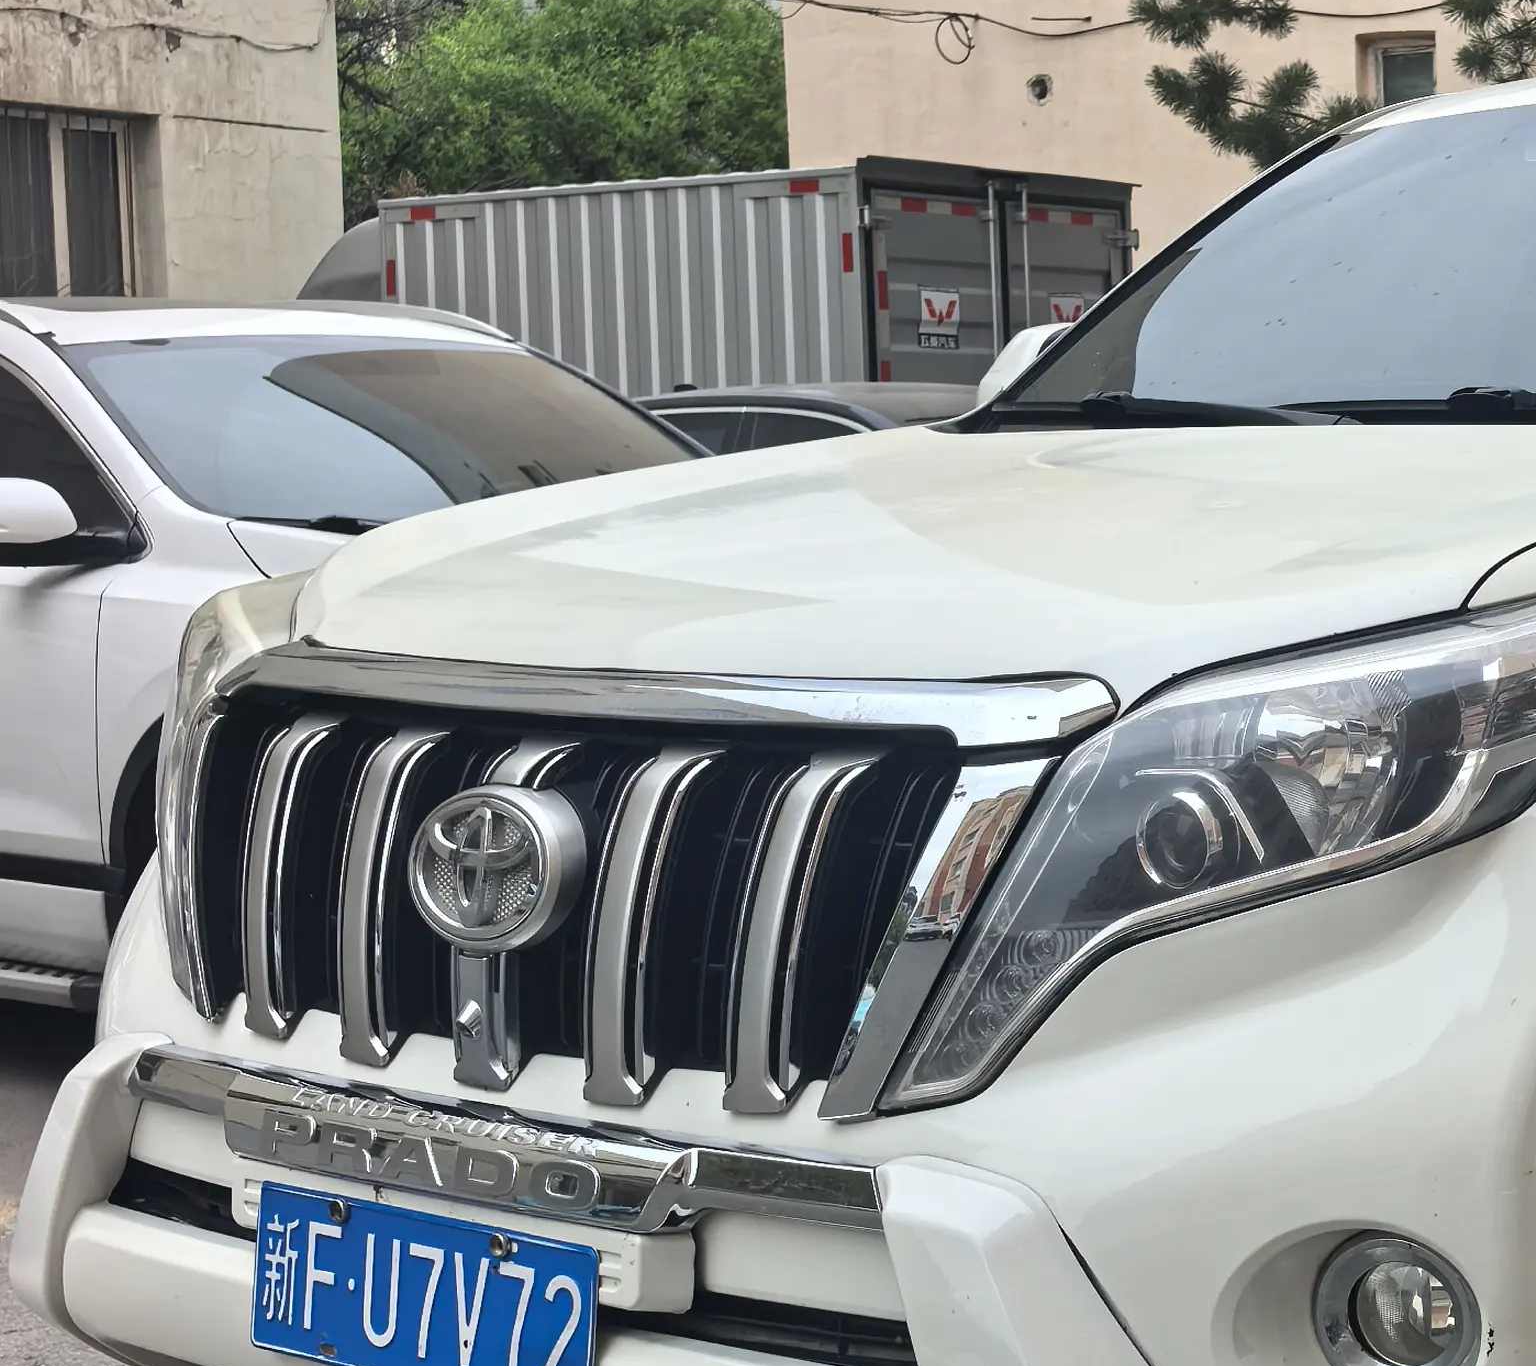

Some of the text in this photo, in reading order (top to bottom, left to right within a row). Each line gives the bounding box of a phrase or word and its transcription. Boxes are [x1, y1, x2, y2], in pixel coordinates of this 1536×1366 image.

[256, 1108, 602, 1211] PRADO
[291, 1085, 603, 1158] LAND CRUISER
